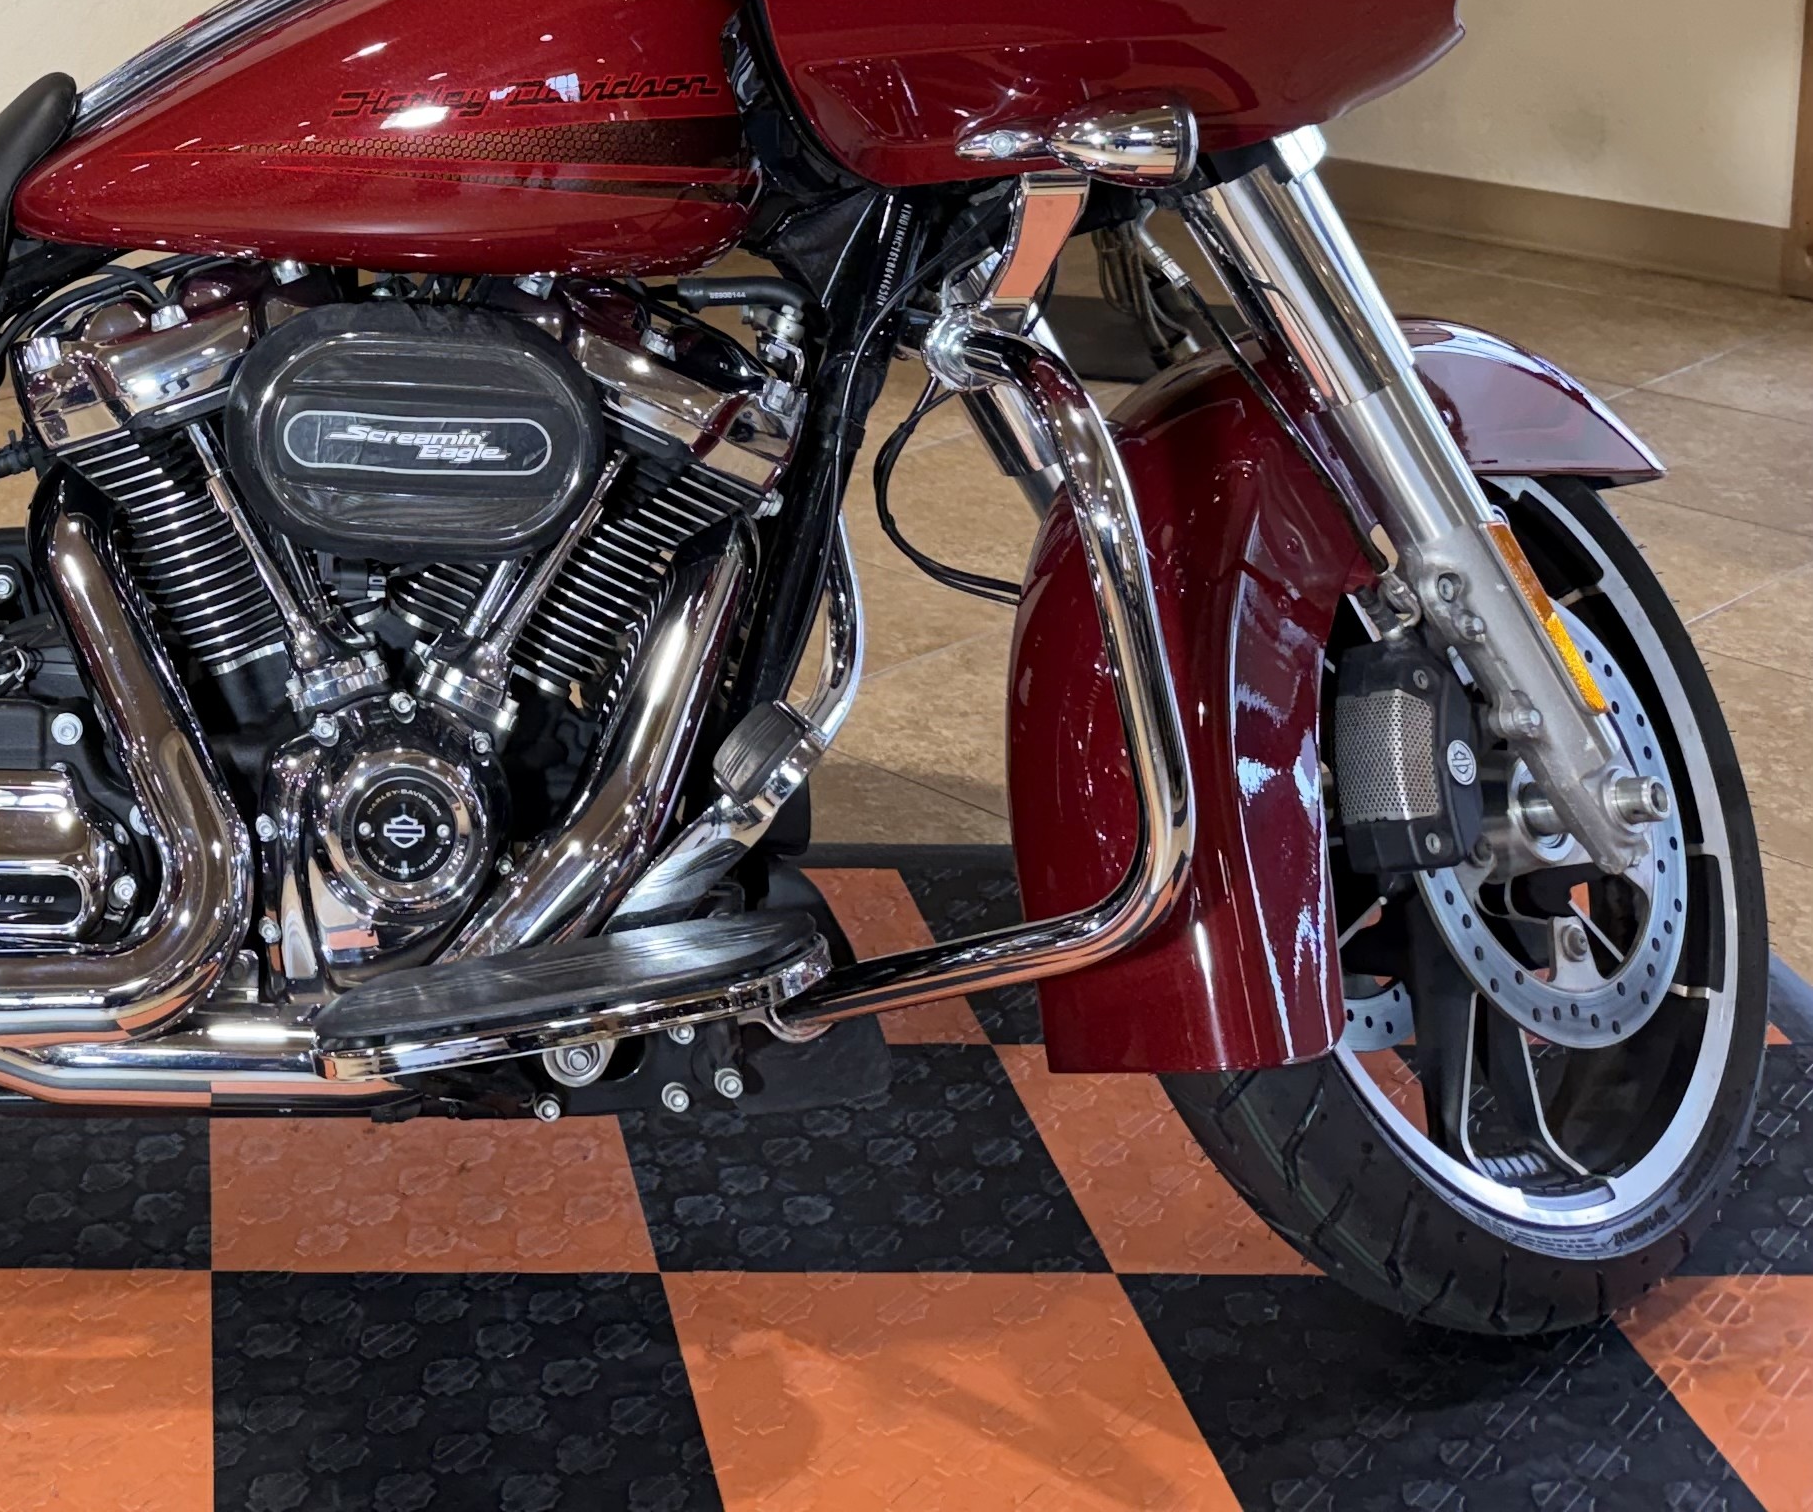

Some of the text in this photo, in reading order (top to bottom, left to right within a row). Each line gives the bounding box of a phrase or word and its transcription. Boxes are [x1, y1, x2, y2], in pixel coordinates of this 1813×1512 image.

[330, 73, 721, 118] HarleyDvidson
[324, 424, 491, 446] Screamin'
[415, 444, 511, 464] Eagle
